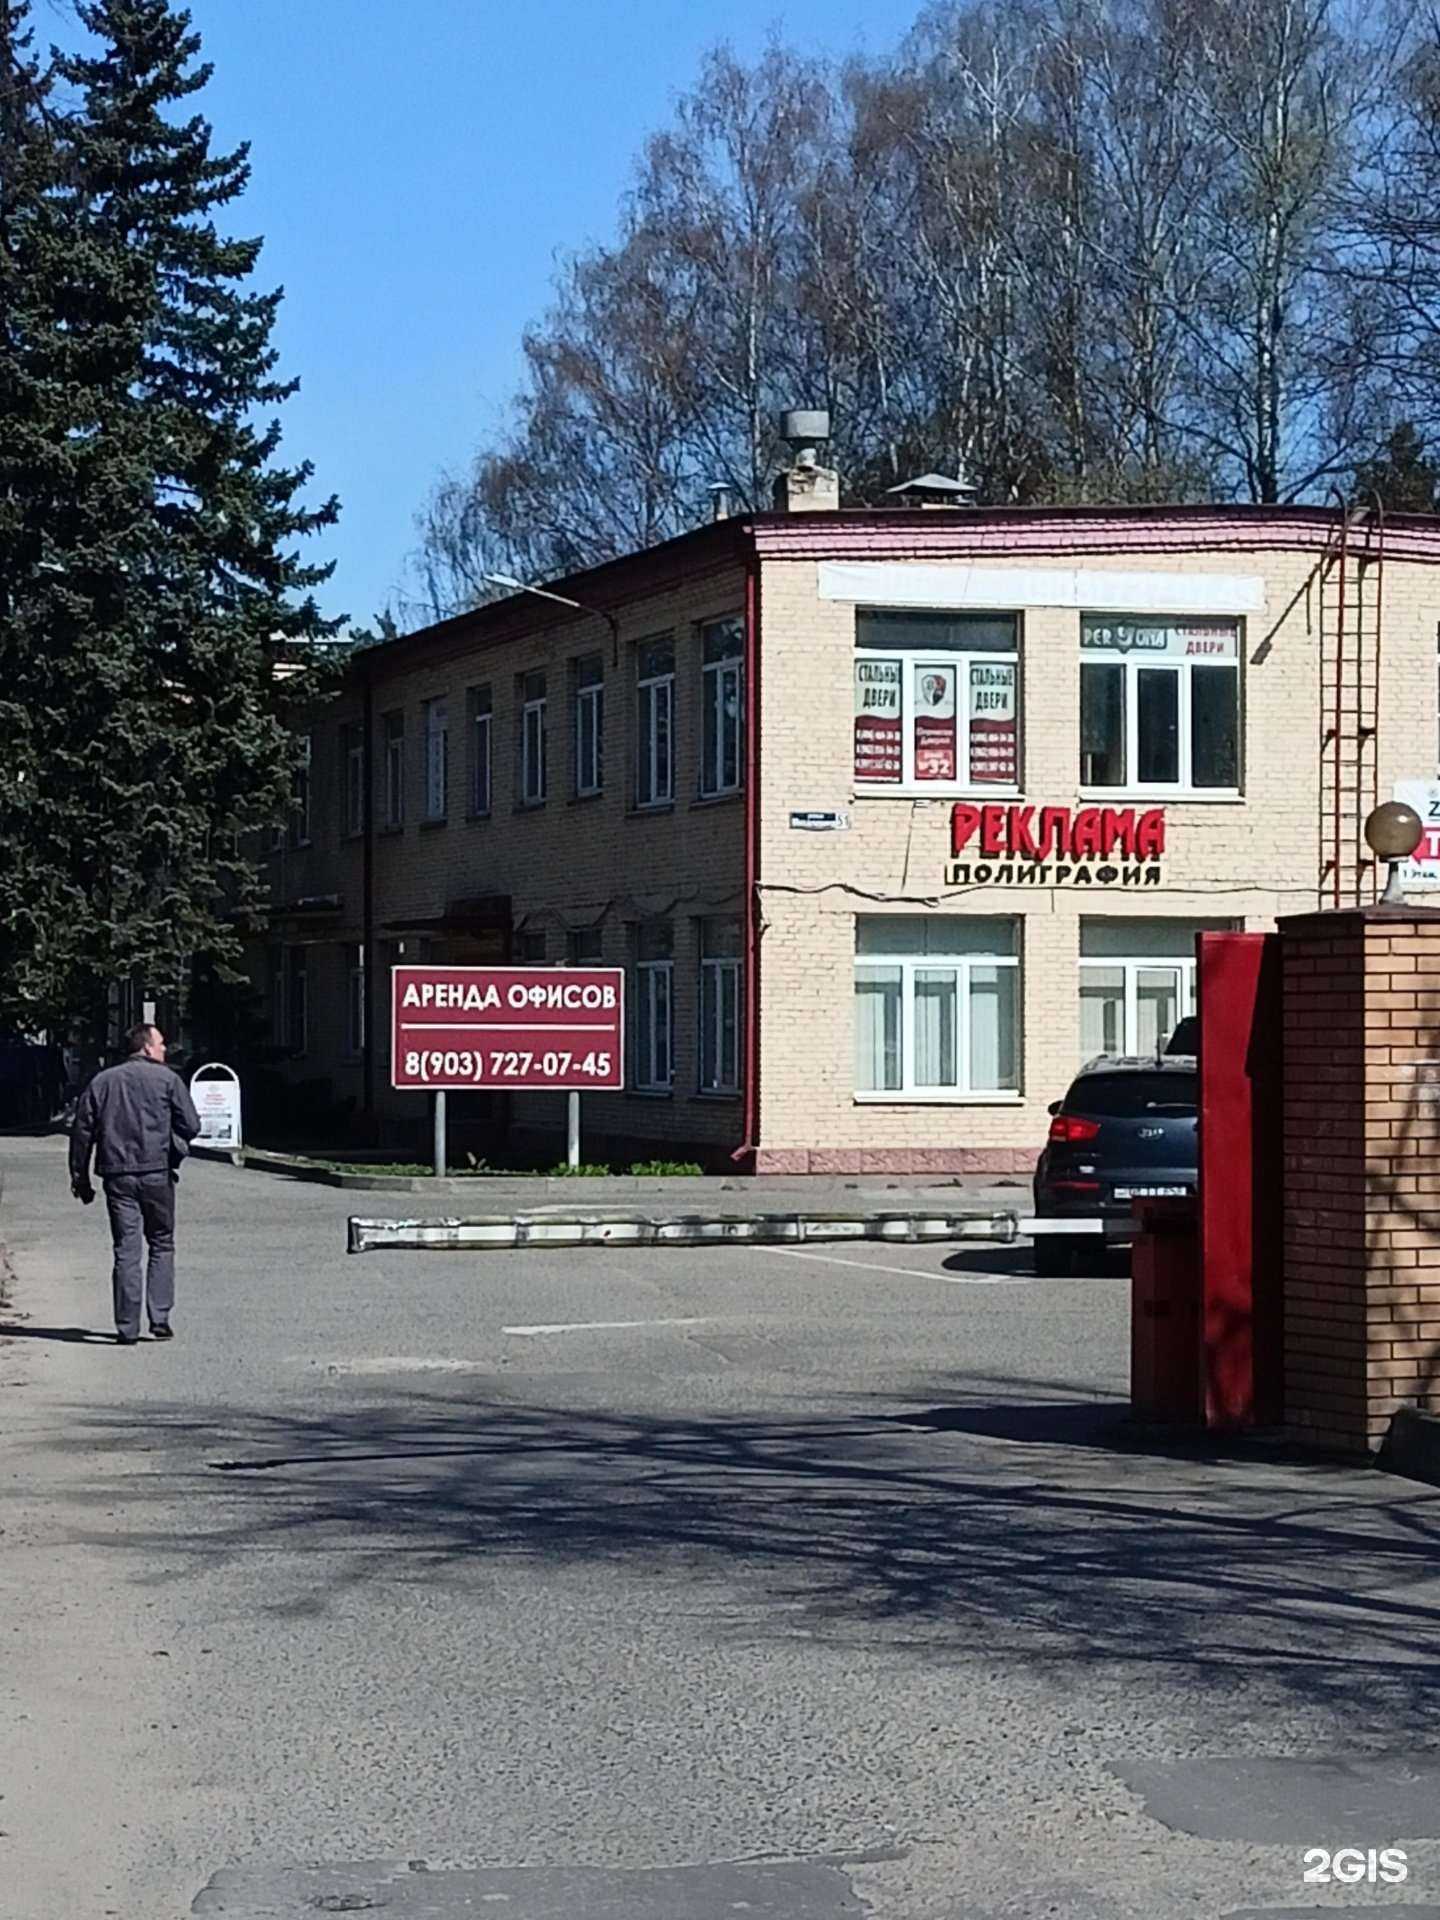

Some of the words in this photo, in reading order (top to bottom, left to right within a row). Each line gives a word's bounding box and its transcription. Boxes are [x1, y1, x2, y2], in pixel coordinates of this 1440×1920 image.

[863, 687, 896, 709] ДВЕРИ
[975, 691, 1008, 712] ДВЕРИ
[951, 803, 1165, 863] РЕКЛАМА
[952, 864, 1161, 886] ПОЛИГРАФИЯ
[402, 983, 502, 1011] АРЕНДА
[508, 984, 616, 1009] ОФИСОВ
[404, 1050, 482, 1081] 8(903)
[490, 1051, 612, 1076] 727-07-45
